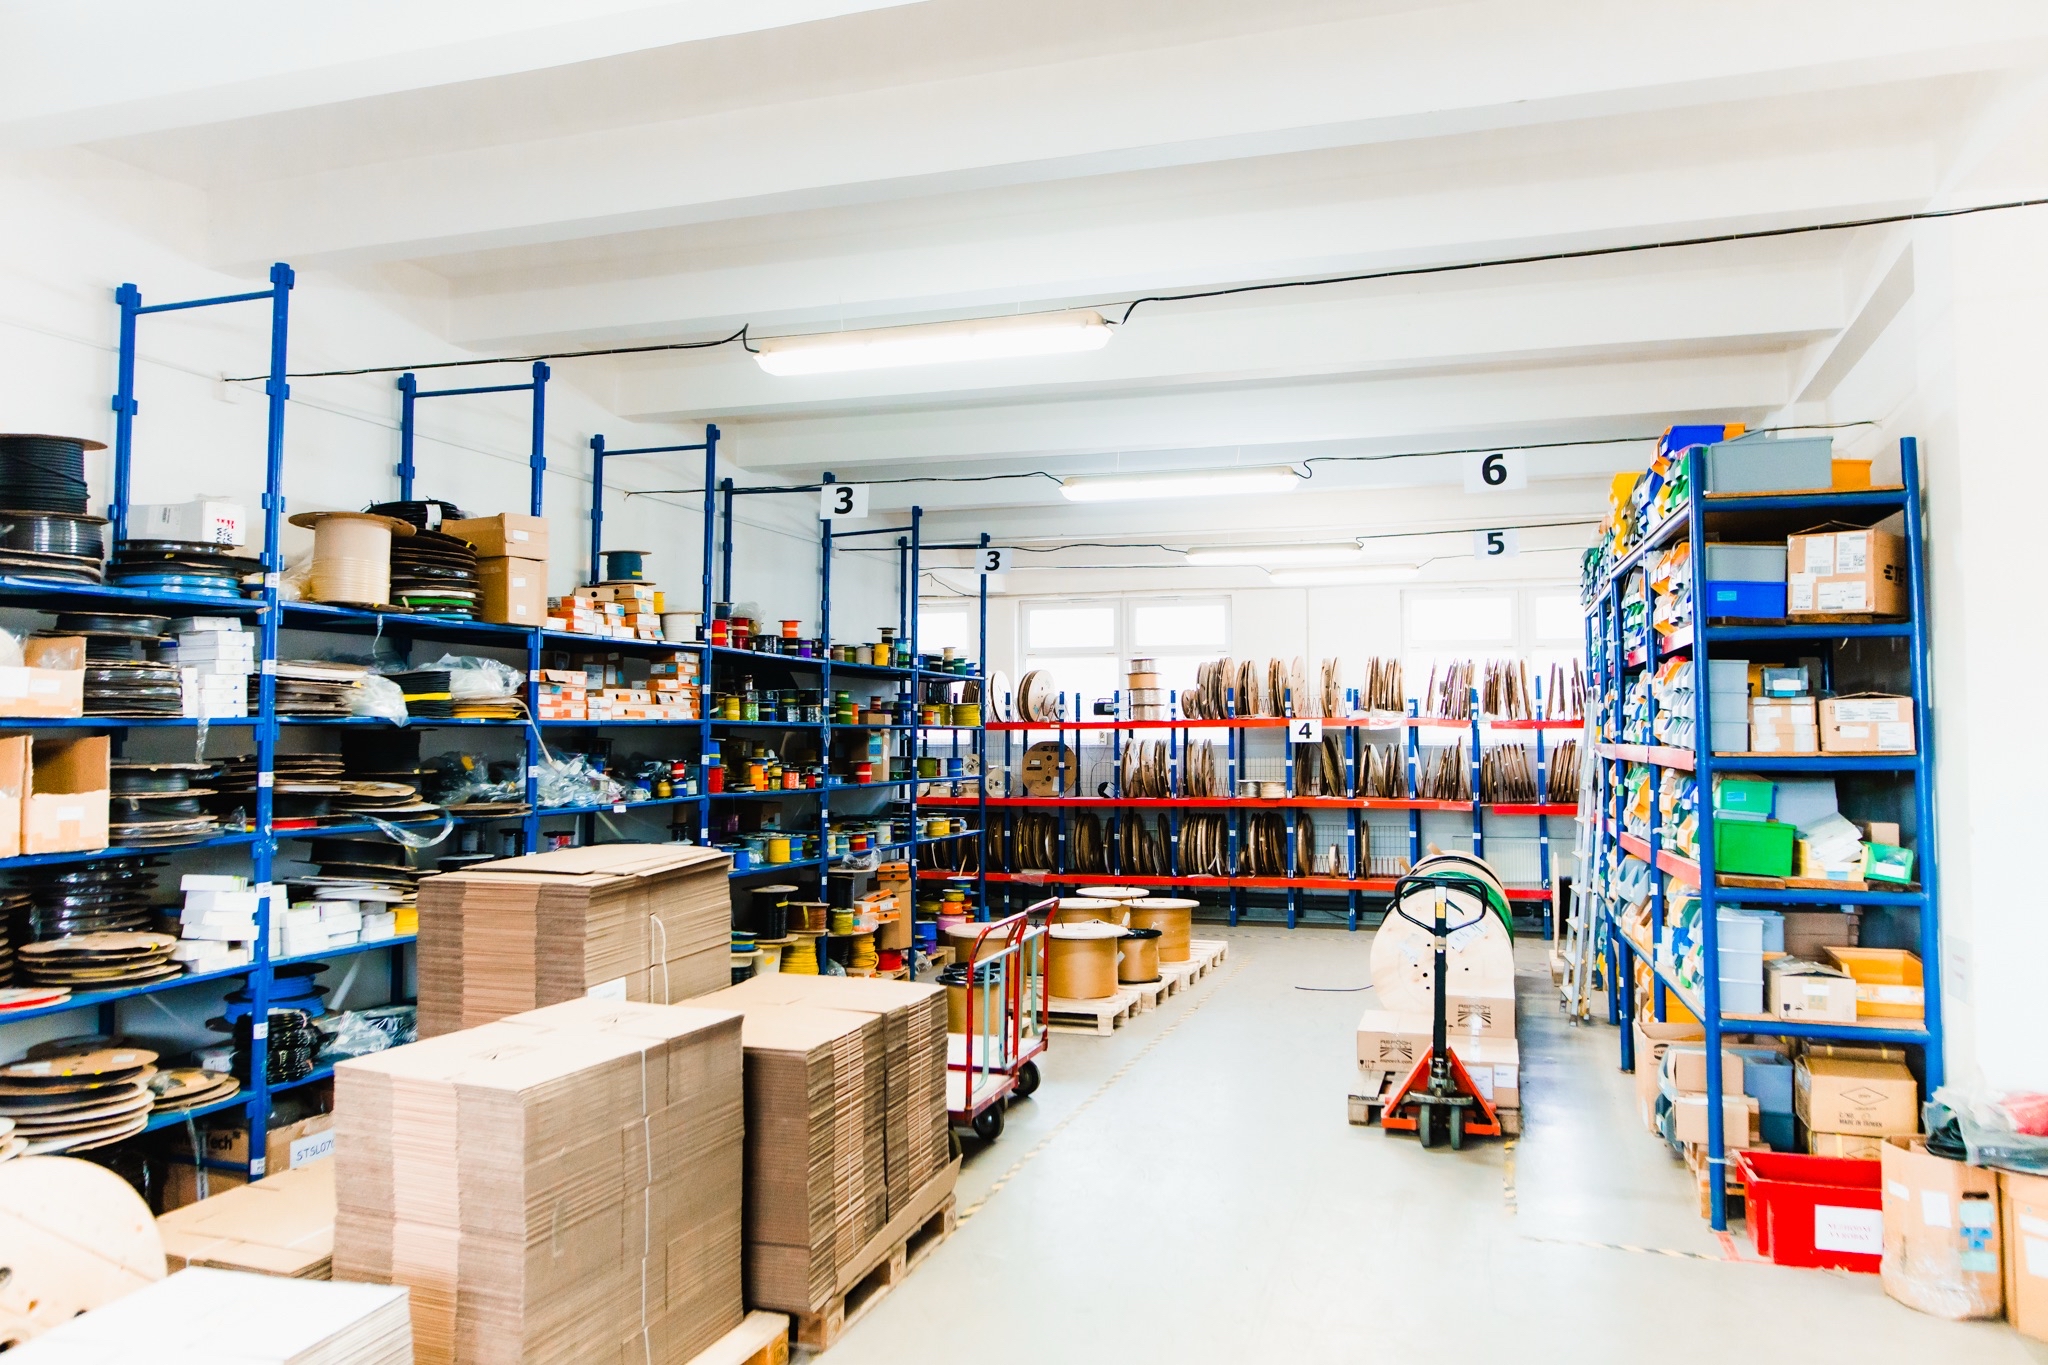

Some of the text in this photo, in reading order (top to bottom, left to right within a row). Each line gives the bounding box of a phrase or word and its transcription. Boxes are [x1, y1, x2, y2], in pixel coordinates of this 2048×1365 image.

[1482, 453, 1507, 485] 6
[834, 486, 854, 514] 3
[1487, 531, 1505, 555] 5
[985, 550, 1001, 571] 3
[1298, 722, 1312, 739] 4
